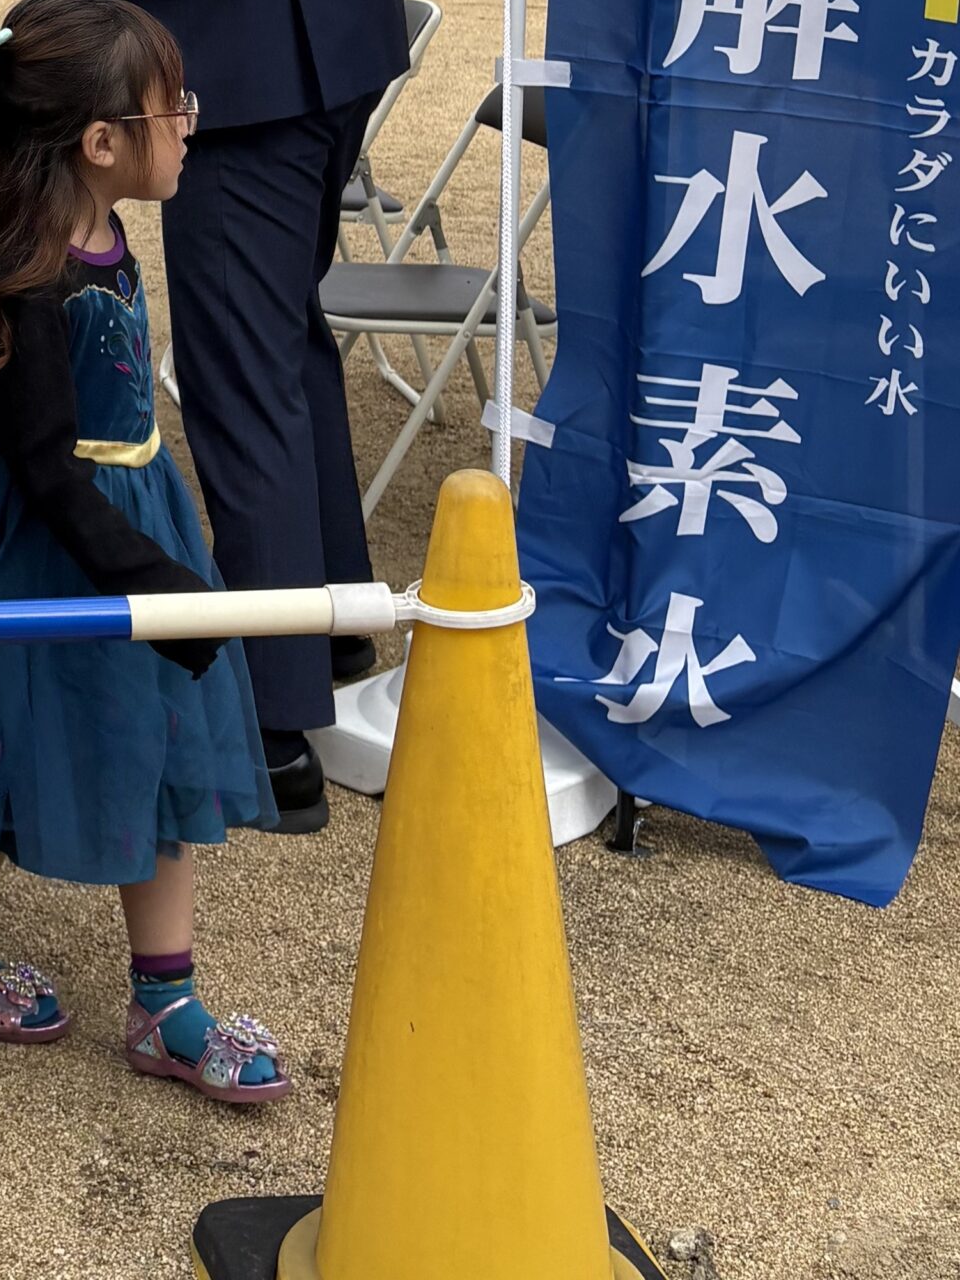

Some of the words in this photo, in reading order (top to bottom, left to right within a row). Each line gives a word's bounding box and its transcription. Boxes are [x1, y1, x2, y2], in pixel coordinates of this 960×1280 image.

[864, 38, 958, 416] カラダにいい水
